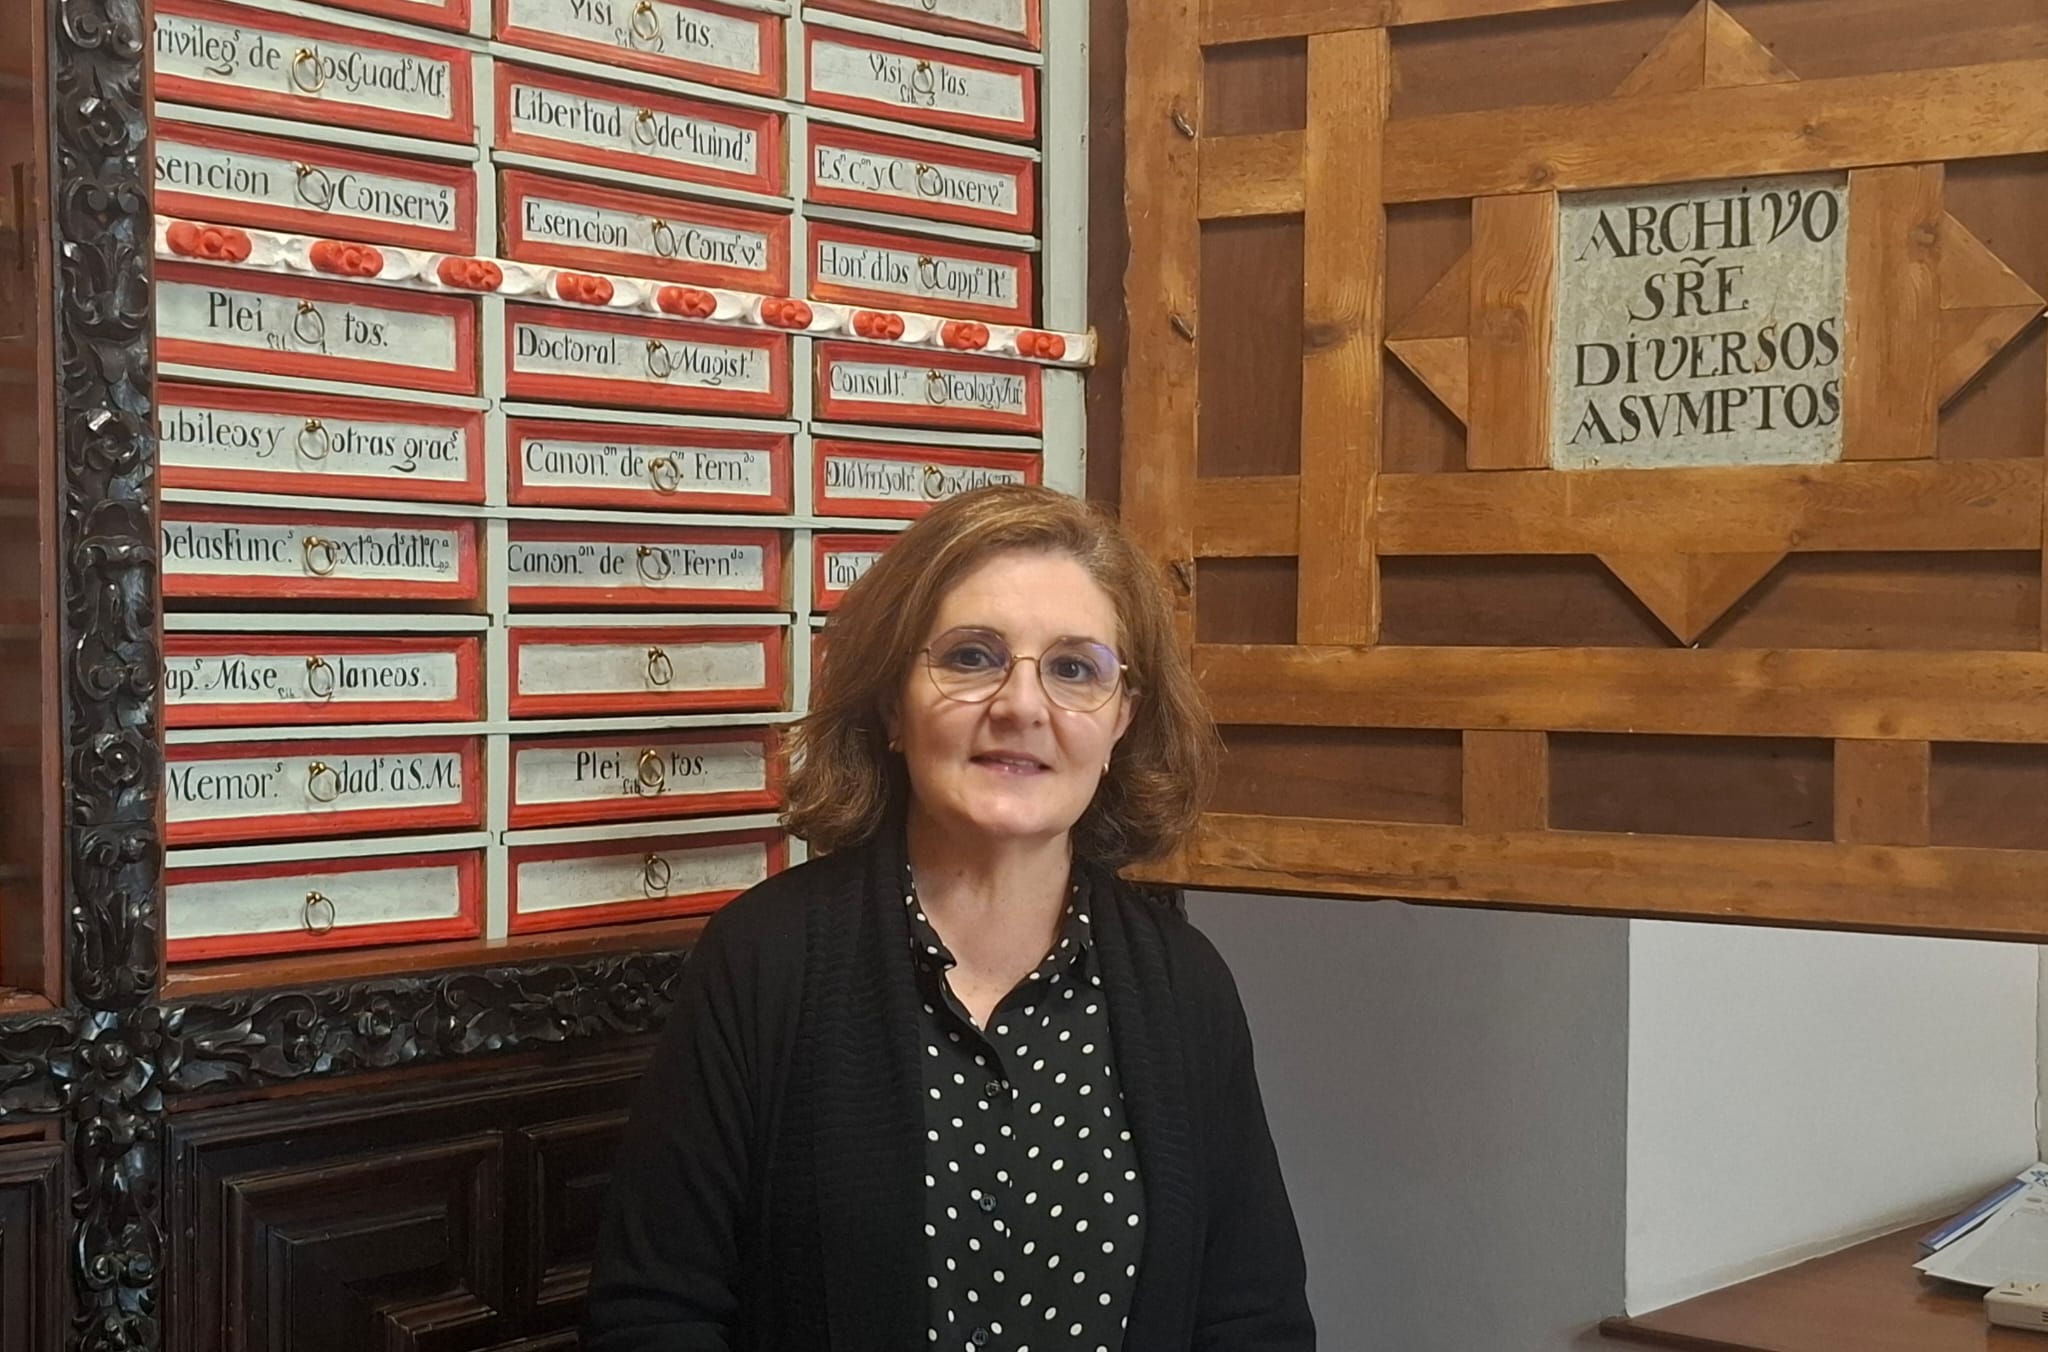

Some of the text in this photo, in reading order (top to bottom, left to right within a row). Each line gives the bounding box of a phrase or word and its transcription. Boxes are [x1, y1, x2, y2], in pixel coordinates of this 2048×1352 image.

[249, 36, 281, 71] de
[512, 87, 622, 138] Libertad
[154, 156, 269, 196] sencion
[525, 200, 628, 248] Esencion
[208, 291, 264, 332] Plei
[158, 408, 260, 448] ubileos
[331, 426, 395, 457] otras
[1566, 379, 1840, 445] ASVMPTOS
[620, 446, 644, 477] de
[599, 546, 625, 575] de
